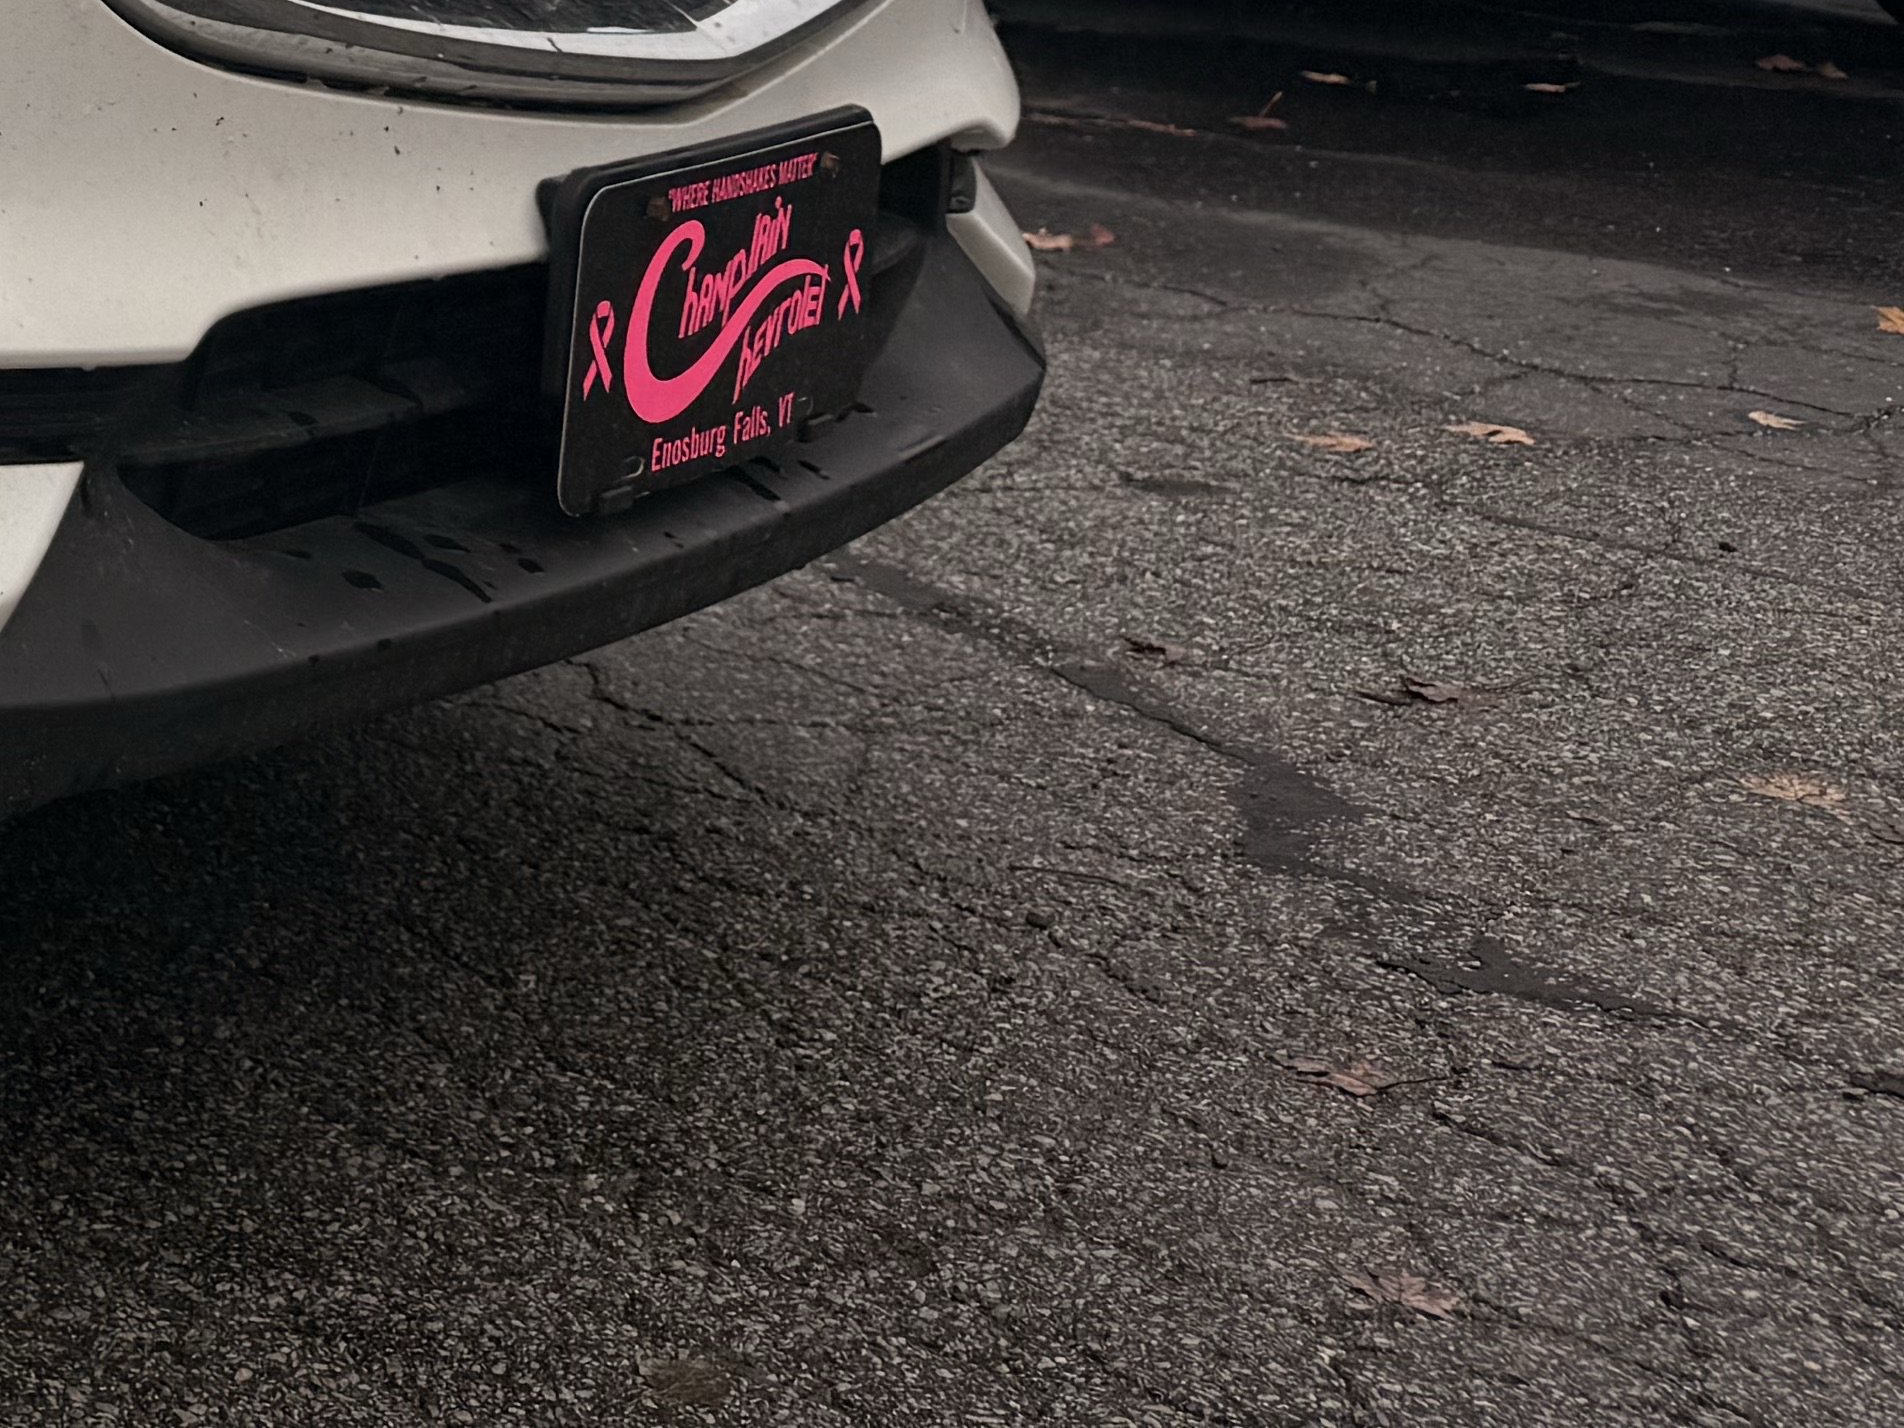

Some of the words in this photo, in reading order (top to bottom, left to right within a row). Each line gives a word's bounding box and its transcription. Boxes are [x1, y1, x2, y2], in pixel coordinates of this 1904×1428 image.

[711, 163, 777, 203] HANDSHAKES
[651, 425, 726, 472] Enosburg
[733, 406, 771, 444] Falls,
[779, 392, 795, 428] VT
